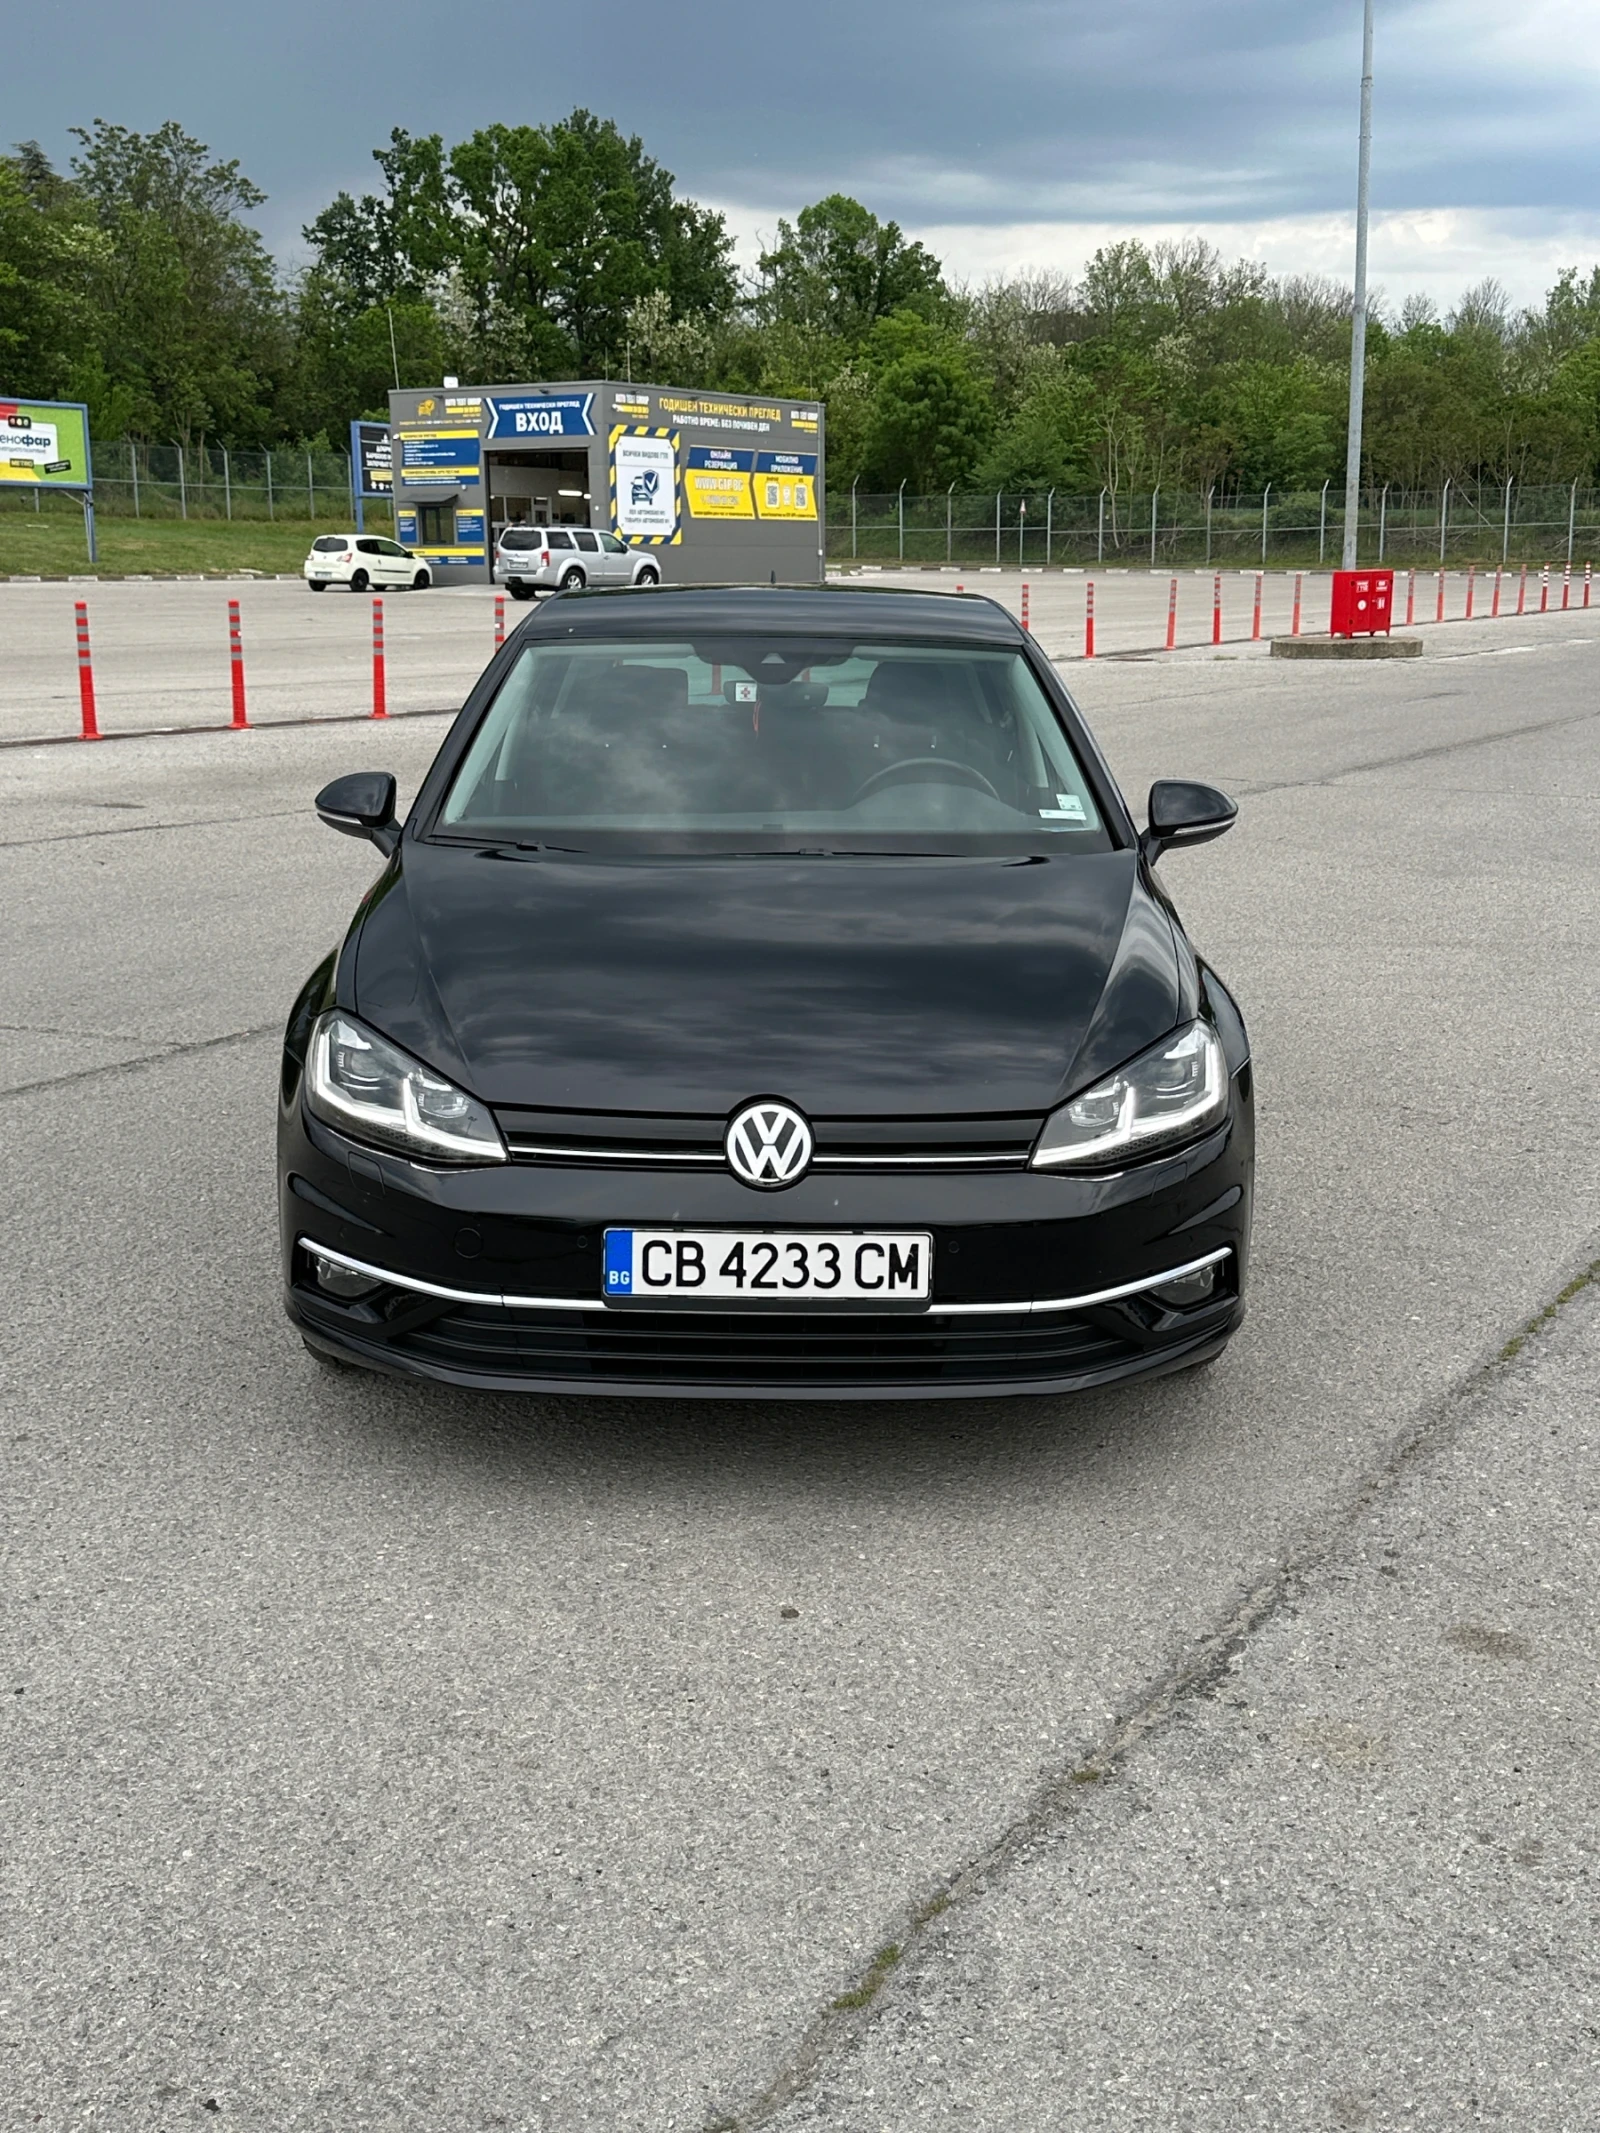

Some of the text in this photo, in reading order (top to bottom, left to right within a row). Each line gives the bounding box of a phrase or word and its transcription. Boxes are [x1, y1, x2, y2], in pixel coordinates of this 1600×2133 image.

[659, 397, 698, 413] ГОДИШЕН
[699, 401, 748, 418] ТЕХНИЧЕСКИ
[748, 406, 782, 422] ПРЕГЛЕД
[515, 411, 564, 434] ВХОД
[672, 414, 699, 425] РАБОТНО
[733, 419, 758, 431] ПОЧИВЕН
[758, 422, 770, 432] ДЕН
[642, 1239, 920, 1290] CB 4233 CM
[608, 1271, 630, 1285] BG
